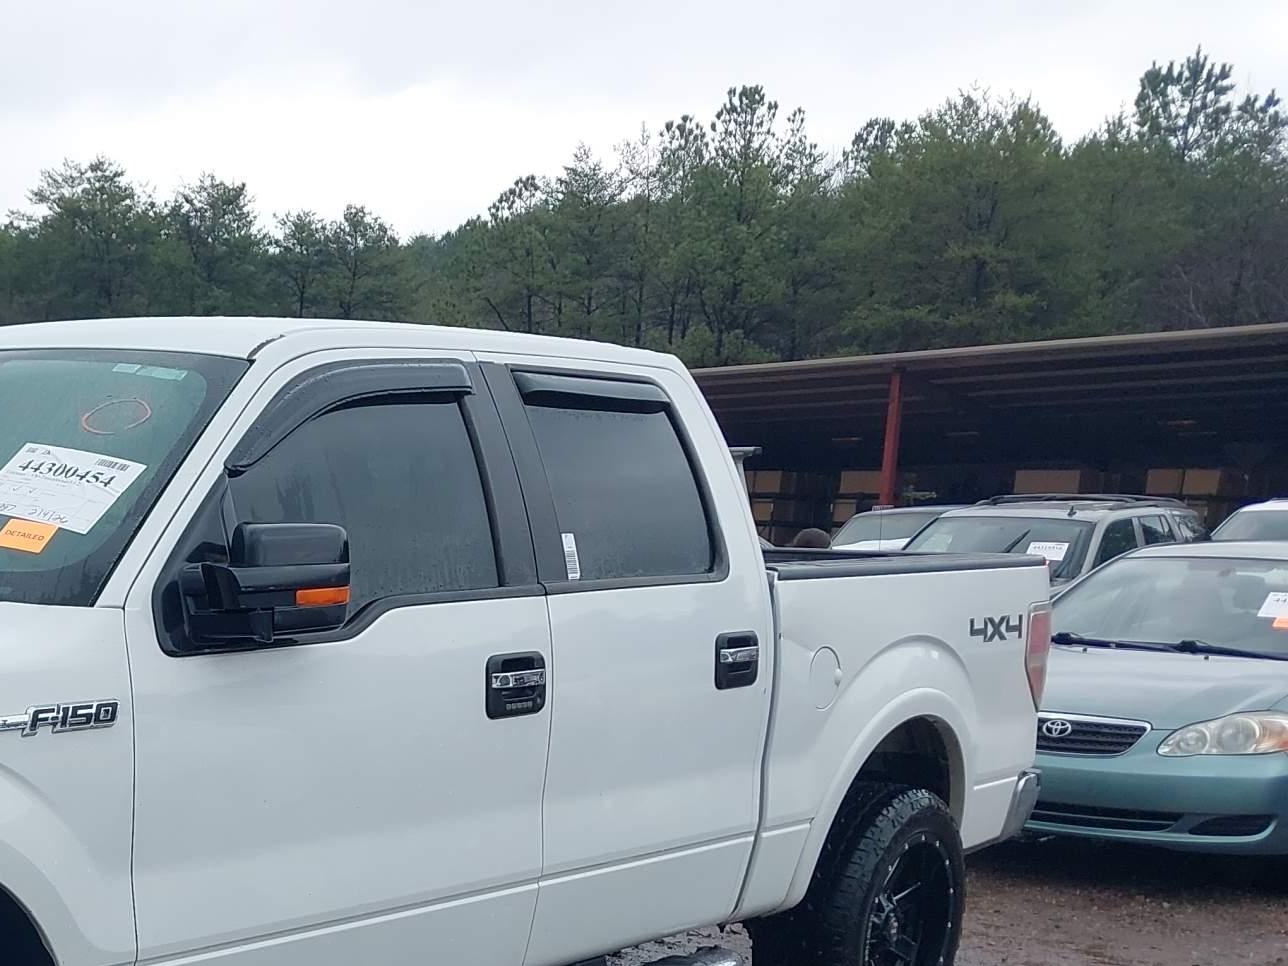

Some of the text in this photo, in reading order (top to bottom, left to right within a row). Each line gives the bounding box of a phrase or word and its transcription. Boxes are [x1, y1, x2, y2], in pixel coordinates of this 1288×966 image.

[18, 459, 116, 487] 44300454
[5, 529, 45, 541] DETAILED
[969, 614, 1023, 643] 4X4
[26, 699, 119, 735] F-150
